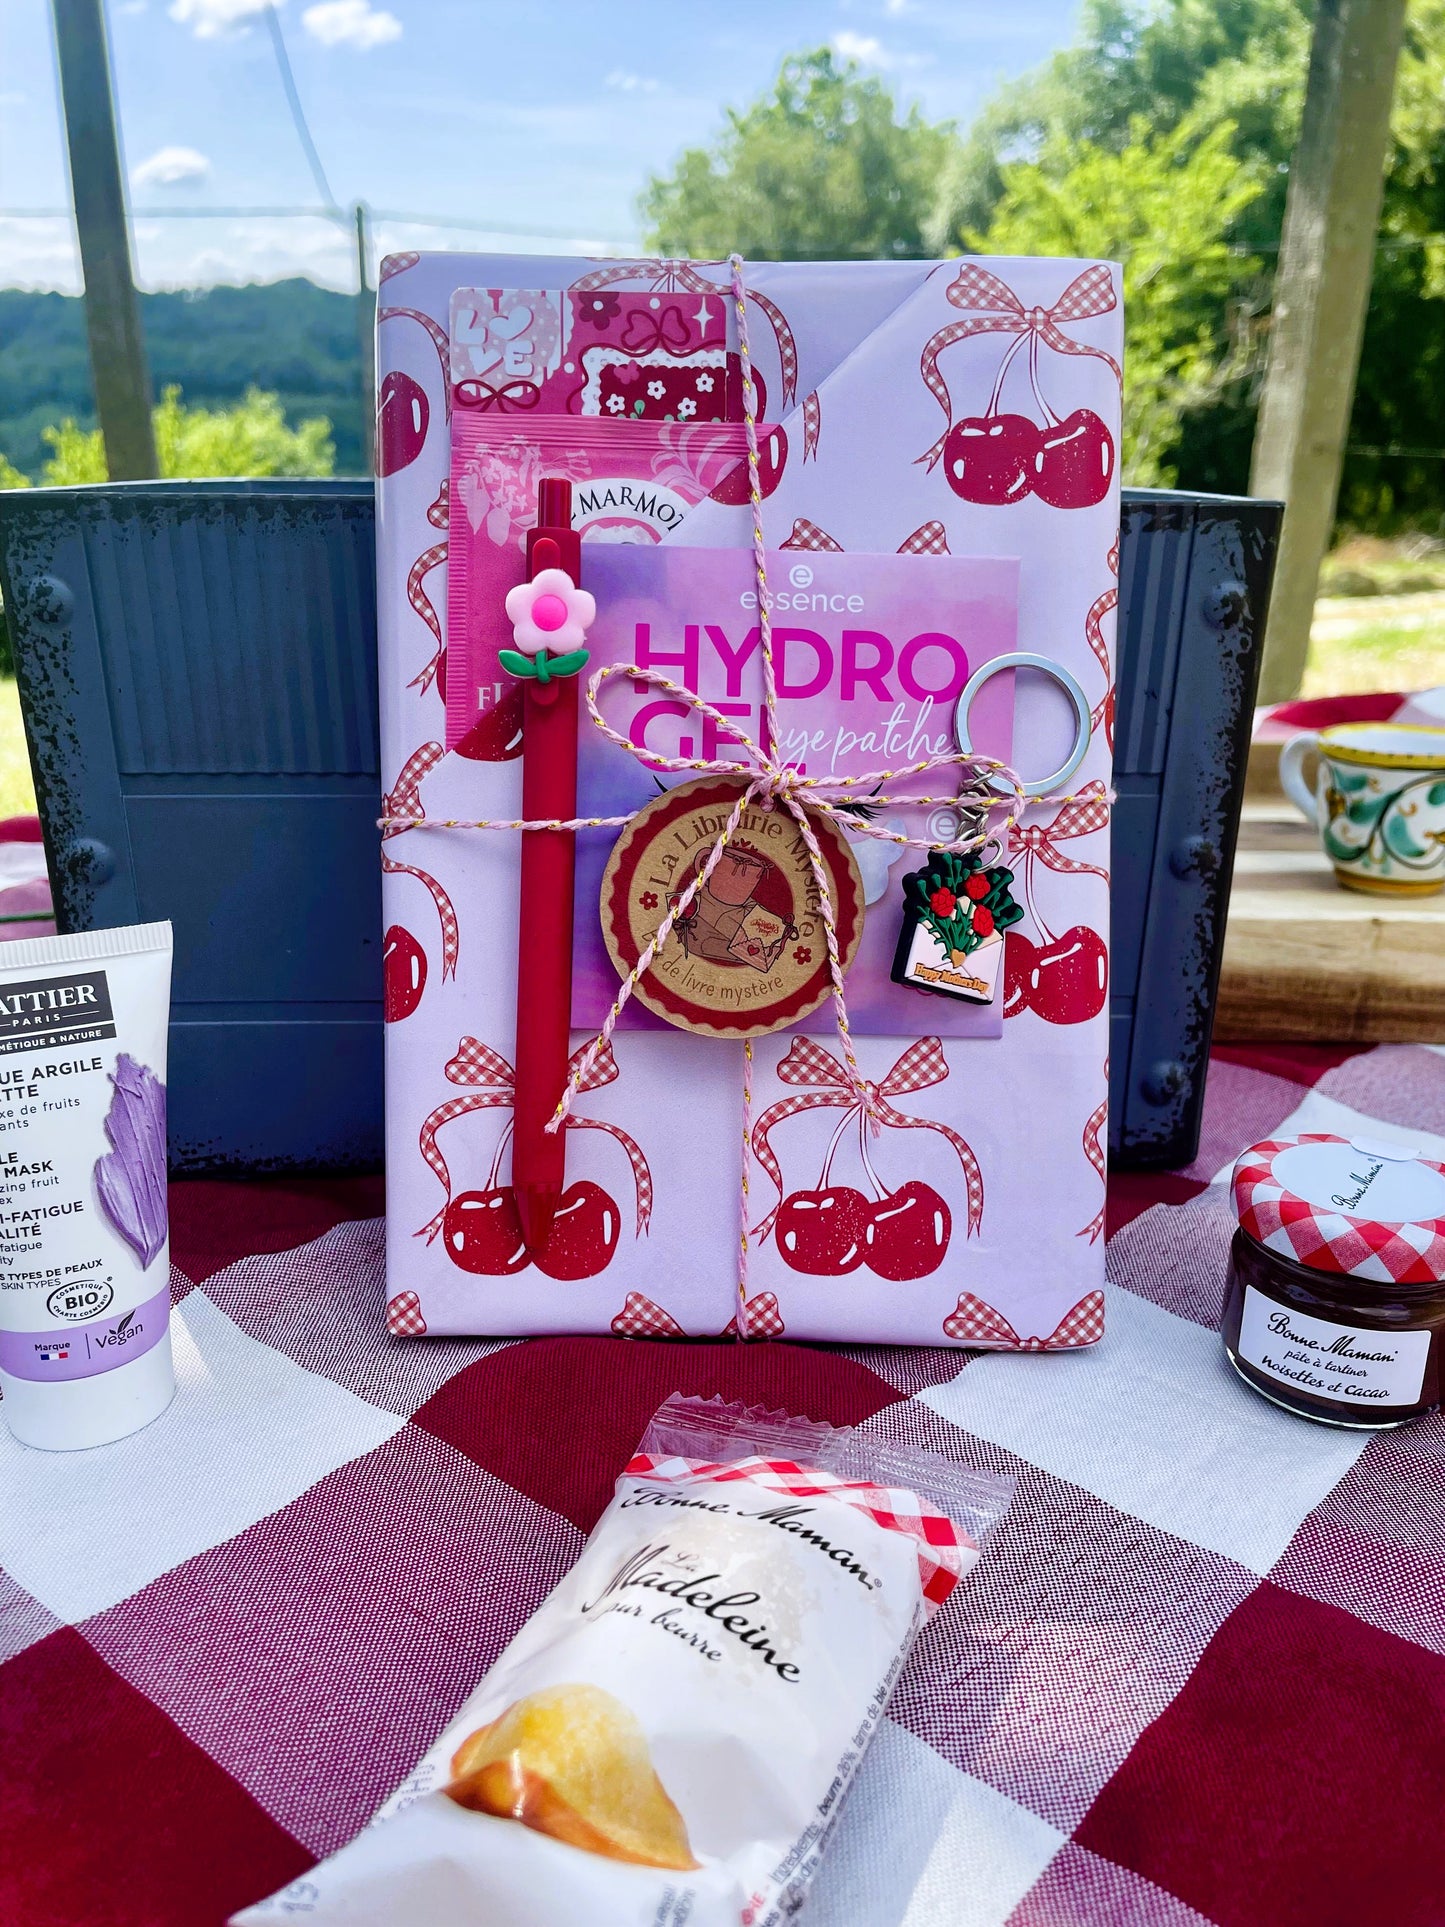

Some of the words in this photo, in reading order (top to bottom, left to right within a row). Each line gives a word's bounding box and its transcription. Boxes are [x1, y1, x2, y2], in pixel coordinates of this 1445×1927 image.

[740, 591, 864, 613] essence
[634, 623, 969, 704] HYDRO
[649, 854, 679, 887] La
[673, 809, 782, 850] Libririe
[662, 955, 682, 978] de
[681, 964, 714, 996] livre
[720, 977, 784, 1006] mystère
[914, 963, 940, 983] Happy
[12, 1013, 60, 1027] PARIS
[49, 1036, 56, 1044] &
[60, 1029, 102, 1043] NATURE
[31, 1057, 103, 1080] ARGILE
[20, 1105, 37, 1115] de
[43, 1098, 80, 1111] fruits
[4, 1160, 54, 1178] MASK
[31, 1176, 60, 1188] fruit
[8, 1270, 42, 1281] TYPES
[46, 1268, 62, 1278] DE
[65, 1259, 103, 1275] PEAUX
[1, 1282, 24, 1290] SKIN
[26, 1278, 61, 1289] TYPES
[65, 1292, 99, 1310] BIO
[34, 1342, 70, 1351] Marque
[96, 1323, 143, 1349] Vegan
[1267, 1312, 1319, 1350] Bonne
[1321, 1335, 1394, 1362] Maman
[1283, 1350, 1311, 1364] pâte
[1313, 1358, 1321, 1368] à
[1325, 1360, 1368, 1377] tartiner
[1327, 1382, 1343, 1393] et
[620, 1487, 730, 1513] Bonne
[737, 1504, 874, 1590] Maman
[581, 1544, 800, 1683] Madeleine
[650, 1608, 722, 1662] beurre
[817, 1776, 842, 1817] beurre
